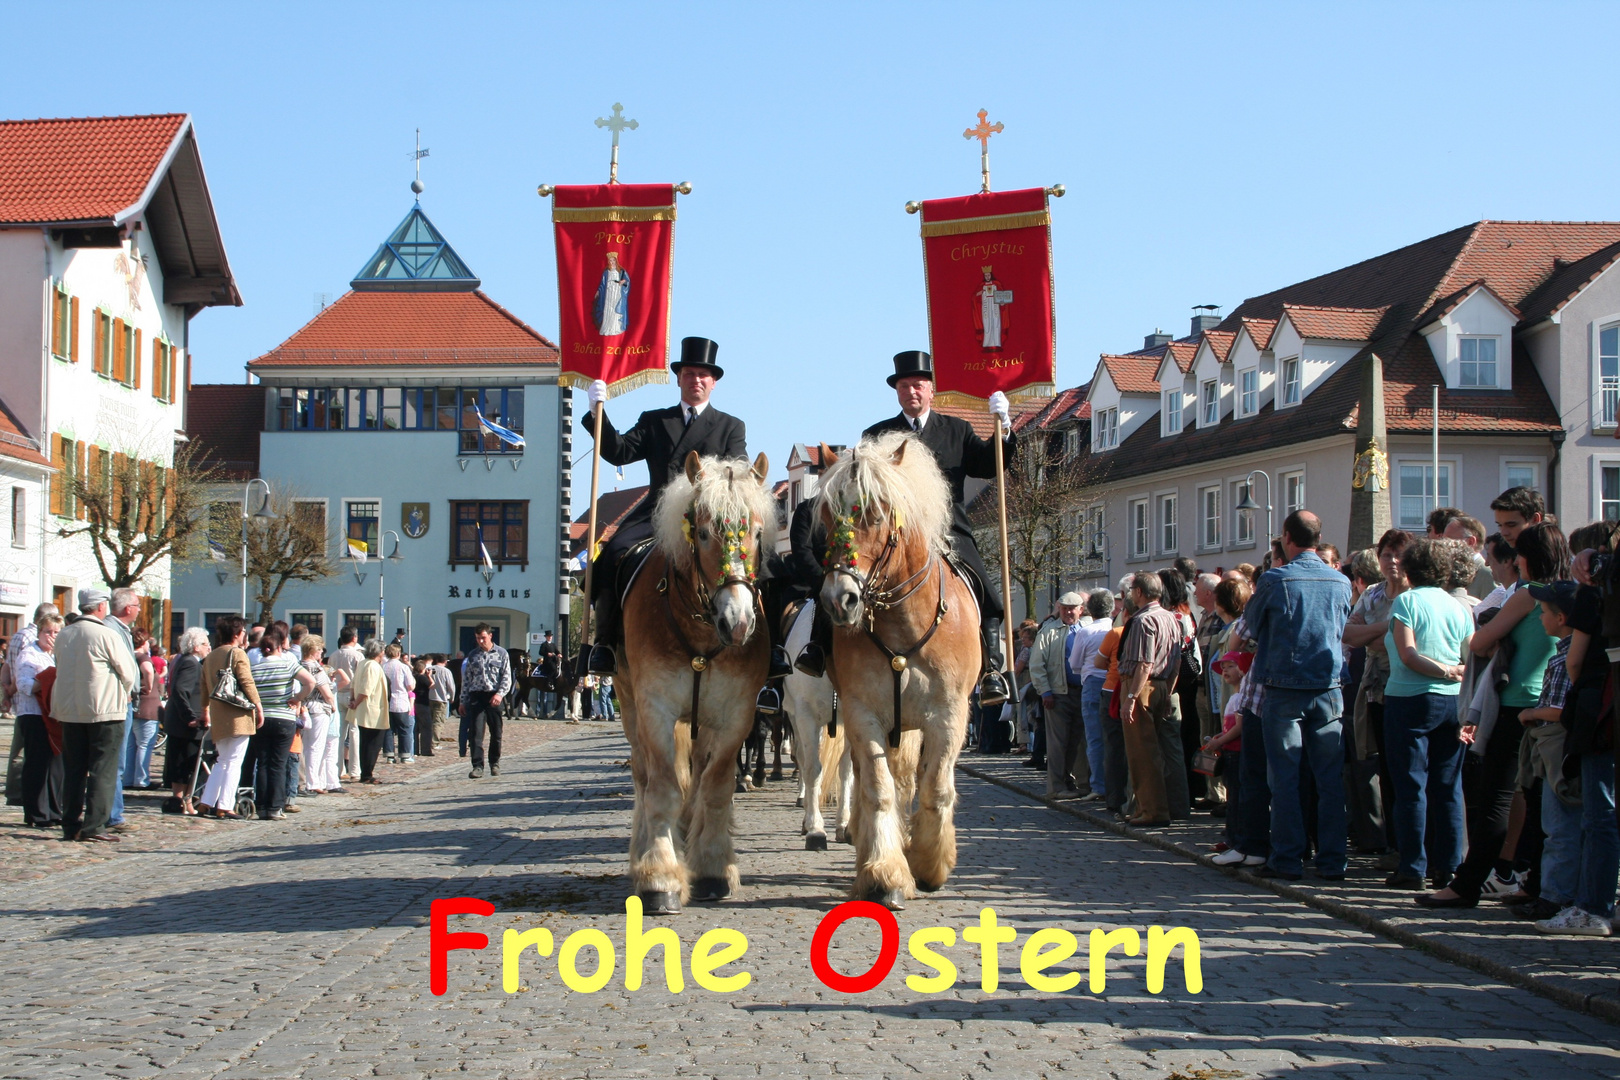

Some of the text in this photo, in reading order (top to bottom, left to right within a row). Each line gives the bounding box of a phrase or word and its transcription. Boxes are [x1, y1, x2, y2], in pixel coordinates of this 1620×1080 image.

[950, 241, 1025, 262] Chrystus
[573, 342, 650, 355] Boha za nas
[990, 352, 1025, 370] Kral
[448, 585, 531, 600] Rathaus
